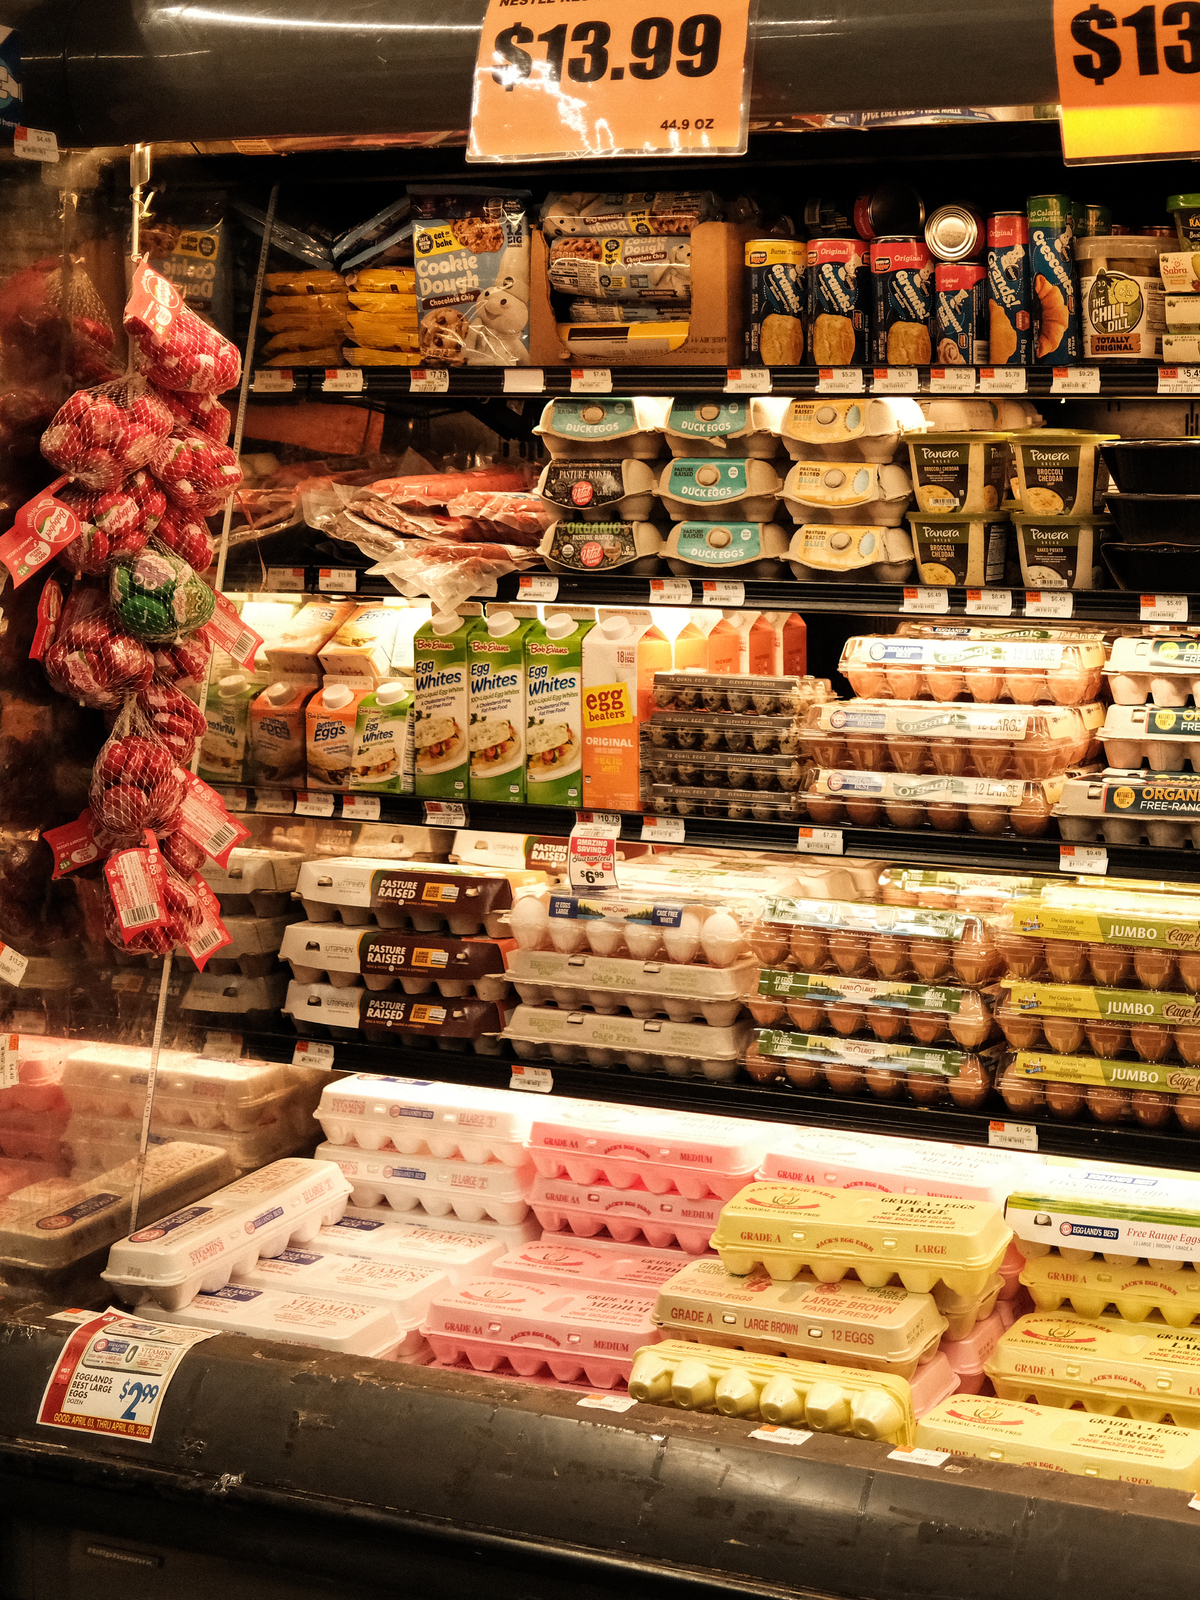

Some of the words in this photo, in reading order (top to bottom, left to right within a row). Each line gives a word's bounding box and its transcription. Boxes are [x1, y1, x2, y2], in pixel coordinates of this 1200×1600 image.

[492, 14, 722, 93] $13.99
[661, 120, 689, 130] 44.9
[694, 119, 714, 129] OZ
[894, 254, 923, 262] Original
[417, 252, 479, 278] Cookie
[419, 272, 479, 296] Dough
[430, 295, 460, 306] Chocolate
[461, 293, 475, 302] Chip
[895, 270, 930, 320] Grands!
[1092, 298, 1106, 306] THE
[1092, 306, 1128, 323] CHILL
[1108, 321, 1130, 333] DILL
[1096, 344, 1134, 352] ORIGINAL
[430, 370, 447, 378] $7.79
[1030, 450, 1070, 461] Panera
[567, 522, 621, 534] ORGANIC
[691, 548, 717, 558] DUCK
[719, 548, 744, 559] EGGS
[472, 640, 486, 652] Bob
[487, 641, 510, 652] Evans
[471, 662, 489, 677] Egg
[472, 673, 517, 690] Whites
[586, 689, 624, 713] egg
[588, 709, 626, 721] beaters
[586, 737, 633, 748] ORIGINAL
[974, 783, 983, 794] 12
[988, 784, 1017, 797] LARGE
[380, 879, 418, 889] PASTURE
[378, 888, 417, 898] RAISED
[1108, 925, 1157, 939] JUMBO
[1167, 928, 1192, 945] Cage
[1102, 1229, 1117, 1237] BEST
[1127, 1227, 1145, 1238] Free
[1148, 1230, 1177, 1242] Range
[1177, 1233, 1200, 1245] Eggs
[671, 1308, 704, 1323] GRADE
[706, 1314, 713, 1324] A
[445, 1322, 471, 1333] GRADE
[473, 1325, 483, 1334] AA
[744, 1318, 770, 1331] LARGE
[772, 1321, 798, 1335] BROWN
[832, 1329, 842, 1340] 12
[845, 1331, 874, 1344] EGGS
[593, 1341, 629, 1352] MEDIUM
[75, 1372, 113, 1385] EGGLANDS
[69, 1388, 88, 1398] EGGS
[72, 1381, 89, 1390] BEST
[90, 1384, 112, 1394] LARGE
[67, 1398, 83, 1406] DOZEN
[53, 1413, 70, 1422] GOOD:
[71, 1415, 86, 1426] APRIL
[96, 1419, 111, 1430] THRU
[112, 1422, 126, 1433] APRIL
[127, 1425, 135, 1435] 09,
[136, 1427, 150, 1436] 2026
